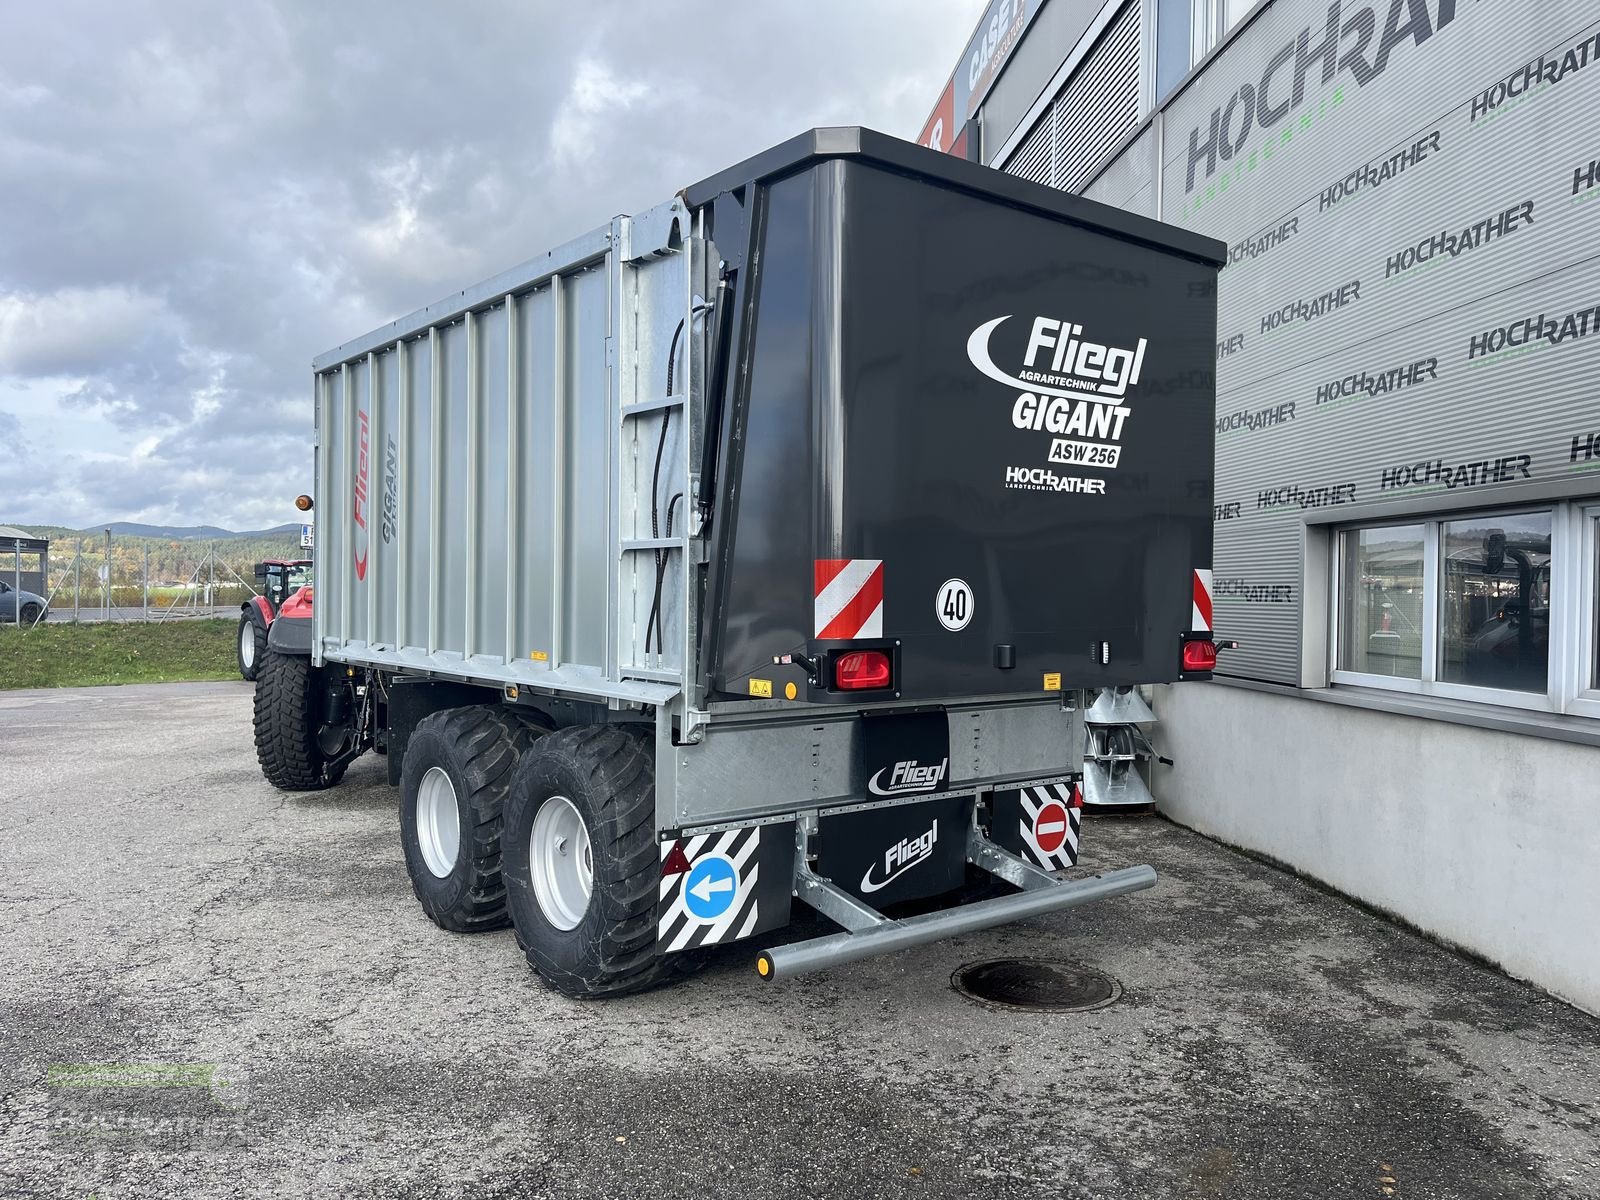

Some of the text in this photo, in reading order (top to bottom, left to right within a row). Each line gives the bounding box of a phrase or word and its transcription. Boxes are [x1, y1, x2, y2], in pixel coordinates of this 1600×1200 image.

[1319, 130, 1441, 213] HOCHRATHER
[1385, 200, 1535, 279] HOCHRATHER
[1260, 281, 1361, 335] HOCHRATHER
[1023, 316, 1148, 396] Fliegl
[1018, 370, 1097, 392] AGRARTECHNIK
[1316, 357, 1438, 406] HOCHRATHER
[1012, 392, 1131, 441] GIGANT
[1052, 443, 1116, 465] ASW 256
[1380, 454, 1531, 490] HOCHRATHER
[382, 433, 396, 544] GIGANT
[1005, 466, 1105, 495] HOCHRATHER
[1005, 483, 1053, 491] LANDTECHNIK
[1257, 483, 1357, 510] HOCHRATHER
[943, 588, 966, 621] 40
[890, 757, 948, 786] Fliegl
[885, 818, 938, 875] Fliegl
